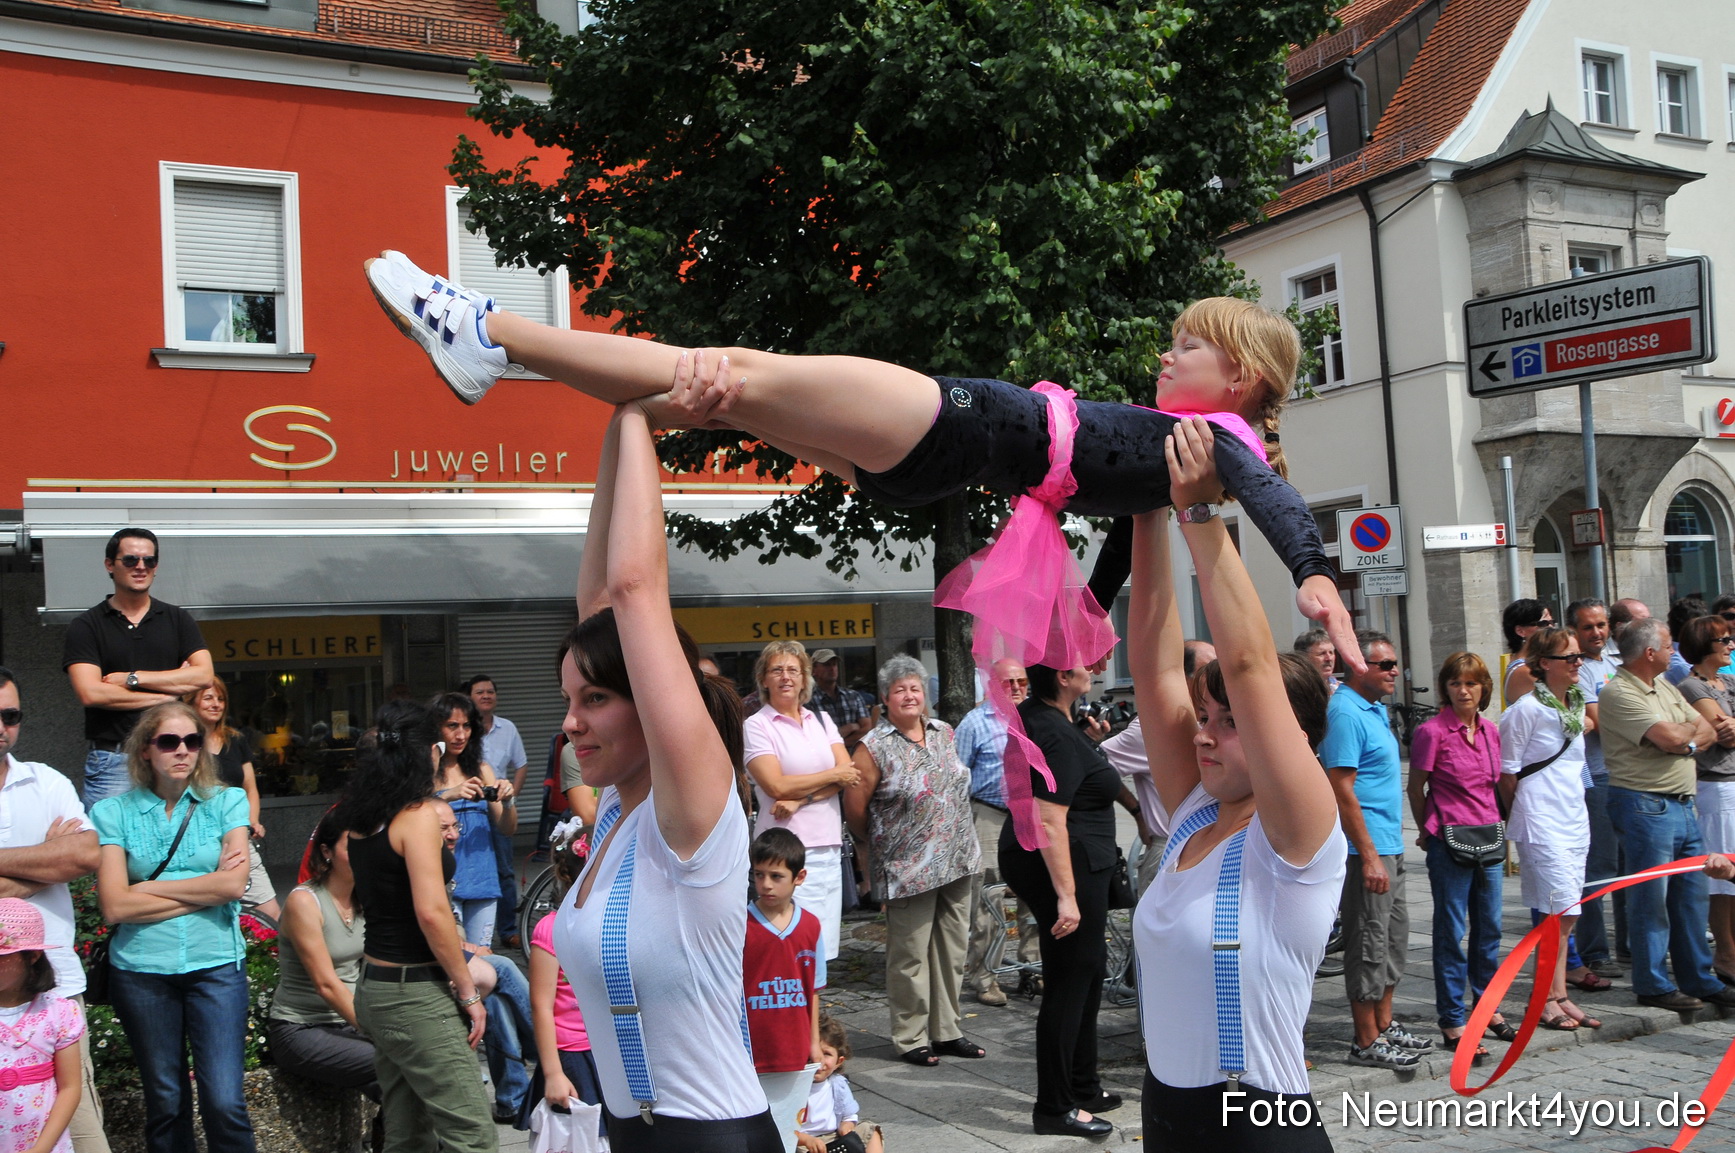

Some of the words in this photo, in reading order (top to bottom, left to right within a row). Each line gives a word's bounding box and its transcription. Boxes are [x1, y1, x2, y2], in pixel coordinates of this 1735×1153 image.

[1501, 284, 1656, 331] Parkleitsystem
[1521, 355, 1534, 375] P
[1556, 331, 1660, 365] Rosengasse
[390, 443, 568, 479] juwelier
[1356, 553, 1389, 566] ZONE
[1368, 574, 1402, 582] Bewohner
[752, 618, 872, 639] SCHLIERF
[224, 635, 378, 658] SCHLIERF
[747, 992, 808, 1010] TELEKO
